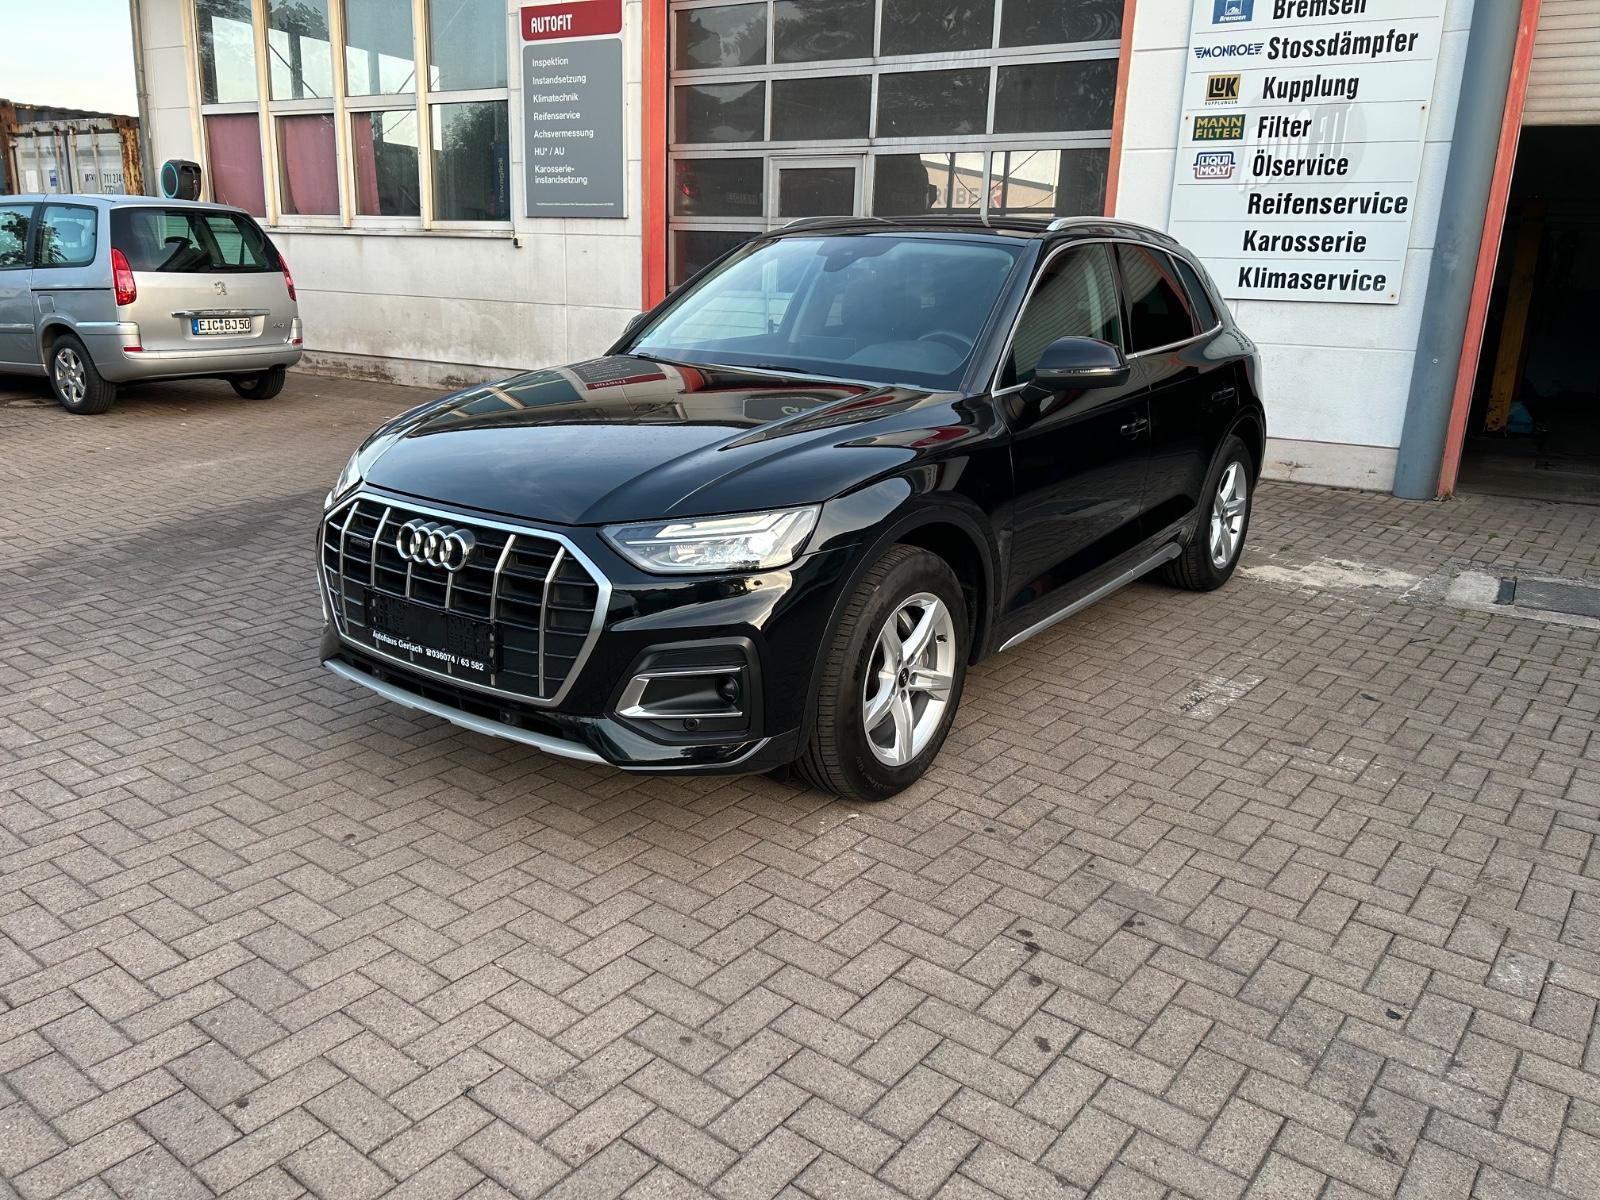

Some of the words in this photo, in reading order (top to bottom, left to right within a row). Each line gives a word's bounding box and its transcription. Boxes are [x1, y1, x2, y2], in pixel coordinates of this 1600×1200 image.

[1272, 0, 1367, 20] Bremsen
[530, 13, 573, 34] AUTOFIT
[1267, 28, 1419, 60] Stossdämpfer
[1201, 43, 1256, 58] MONROE
[532, 56, 569, 68] Inspektion
[532, 74, 587, 85] Instandsetzung
[1262, 73, 1360, 102] Kupplung
[532, 92, 579, 103] Klimatechnik
[533, 111, 581, 121] Reifenservice
[1196, 116, 1243, 128] MANN
[1257, 115, 1313, 139] Filter
[533, 129, 594, 138] Achsvermessung
[1195, 128, 1242, 139] FILTER
[554, 147, 566, 156] AU
[1200, 155, 1230, 166] LIQUI
[1252, 149, 1350, 177] Ölservice
[534, 164, 575, 173] Karosserie-
[1200, 165, 1229, 176] MOLY
[534, 175, 588, 186] instandsetzung
[1247, 191, 1409, 215] Reifenservice
[1242, 229, 1368, 253] Karosserie
[1237, 266, 1387, 292] Klimaservice
[372, 629, 398, 646] Autohaus
[398, 639, 423, 654] Gerlach
[470, 661, 484, 672] 582
